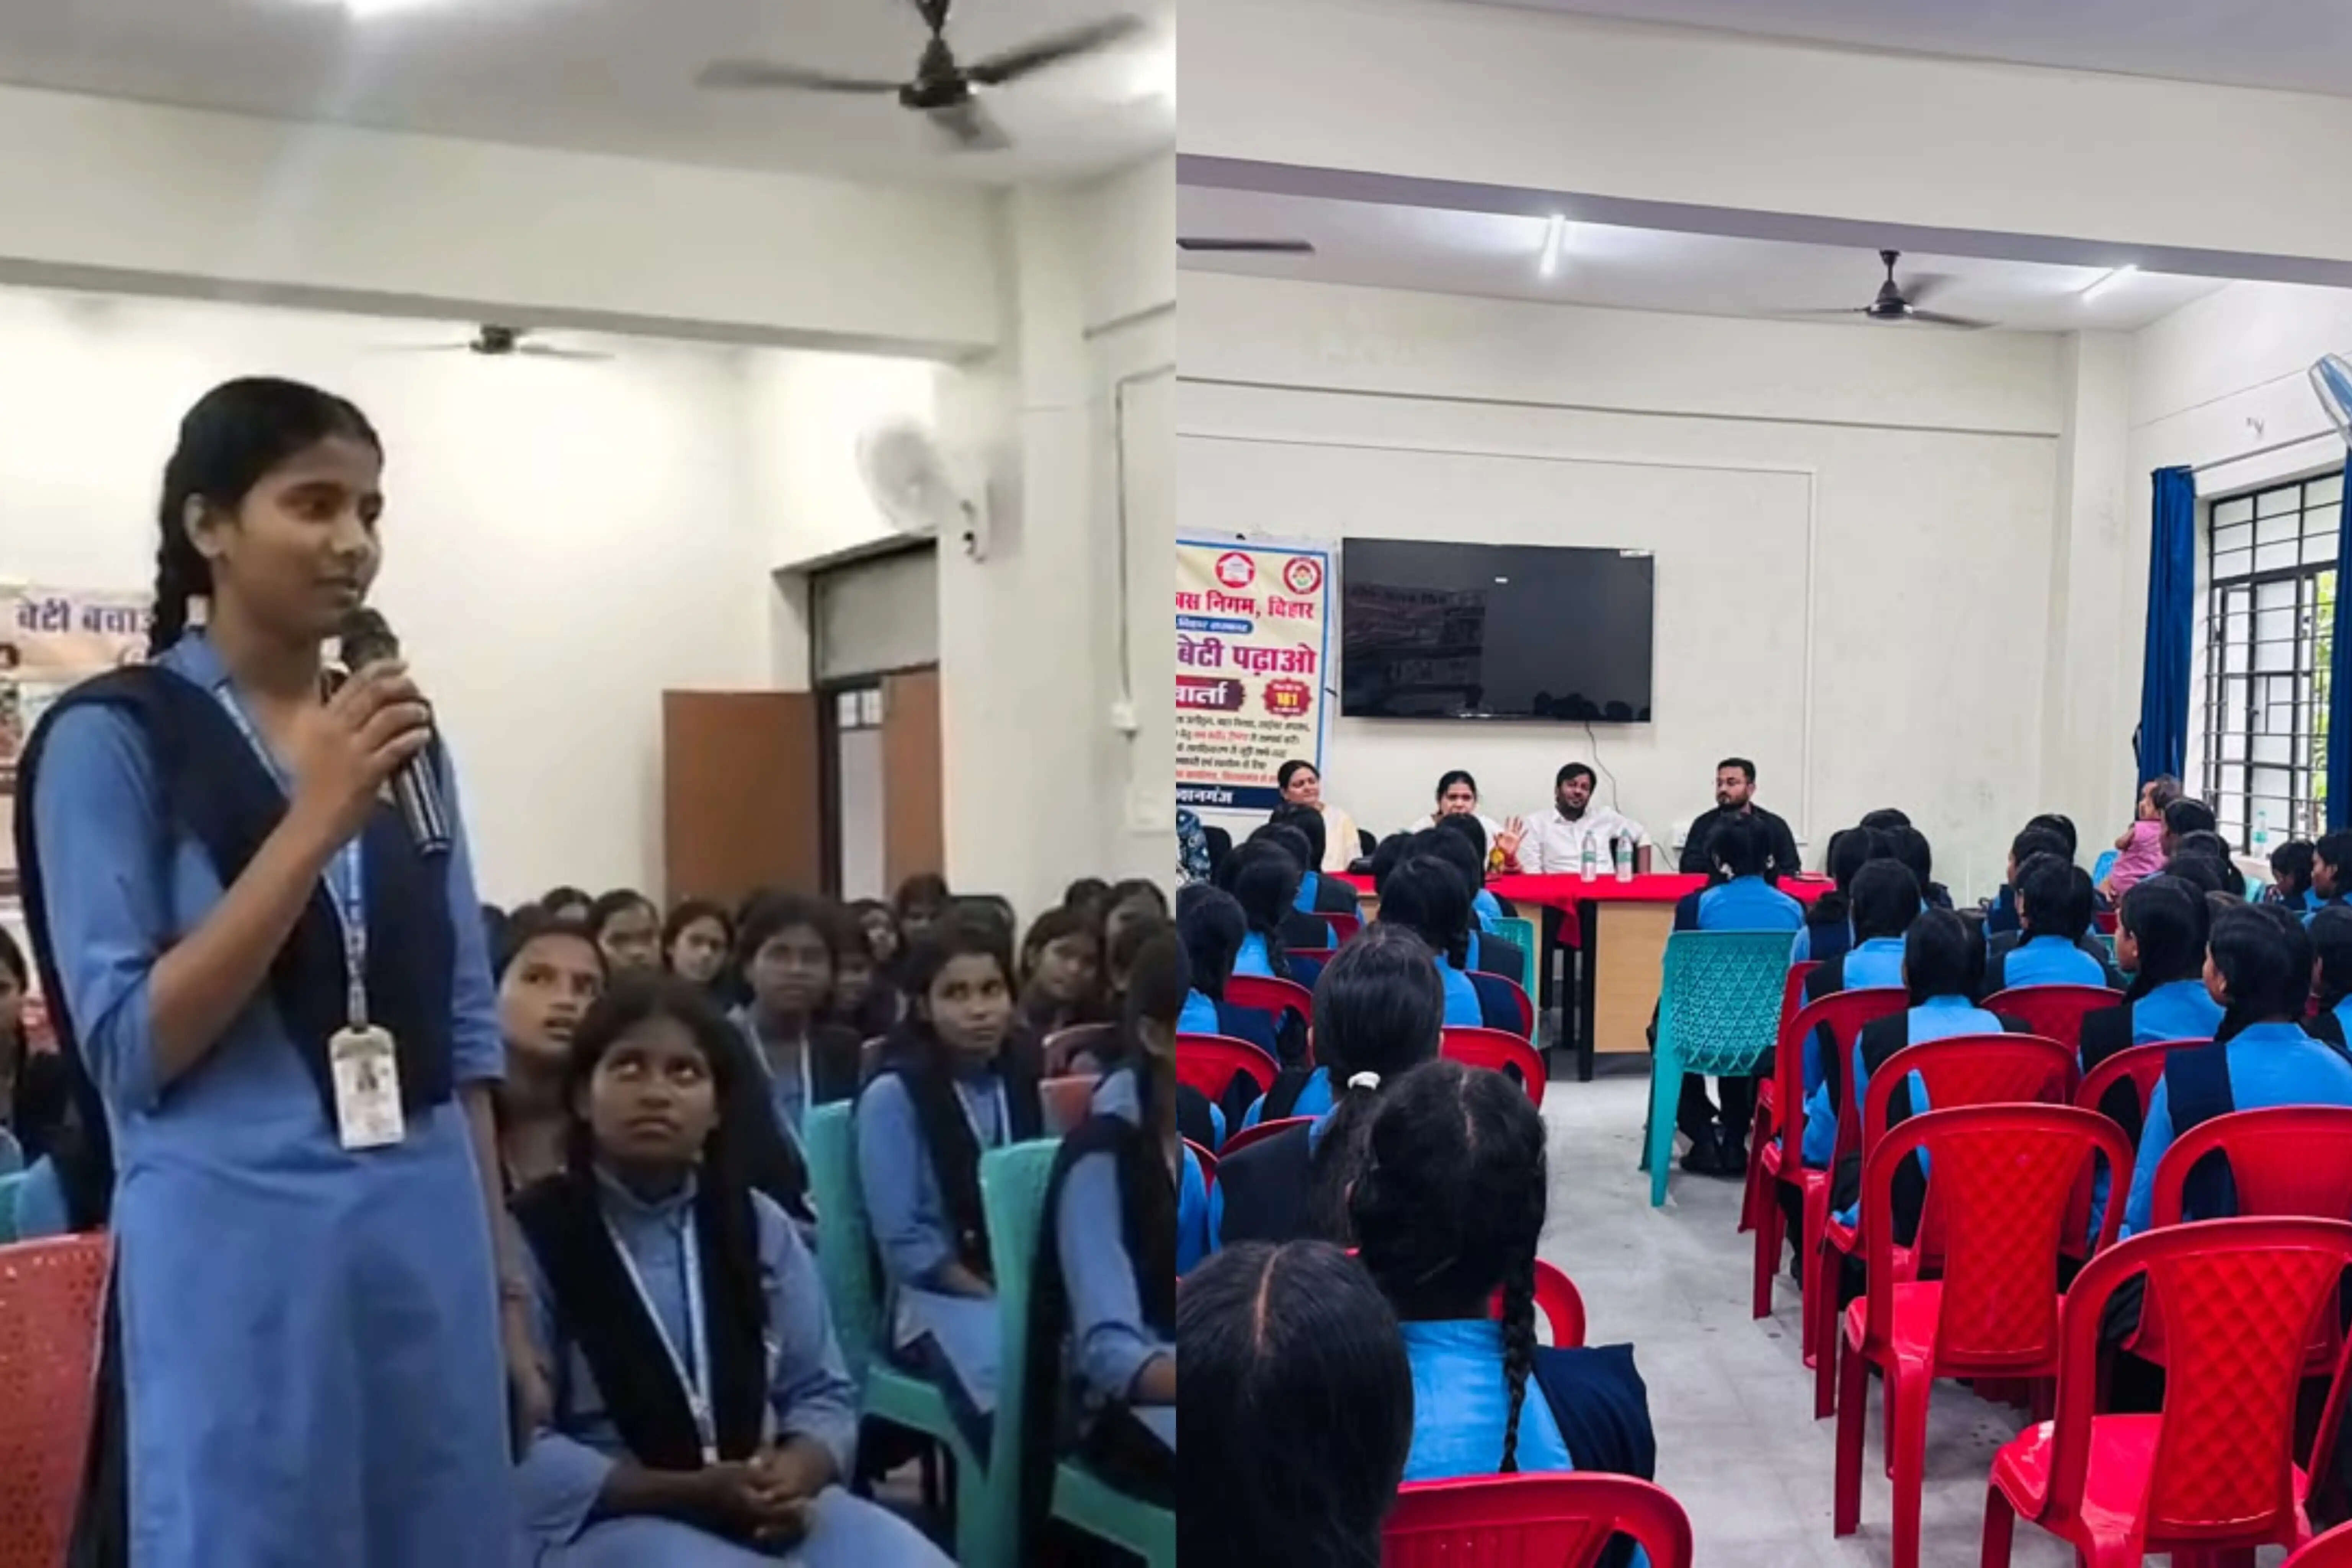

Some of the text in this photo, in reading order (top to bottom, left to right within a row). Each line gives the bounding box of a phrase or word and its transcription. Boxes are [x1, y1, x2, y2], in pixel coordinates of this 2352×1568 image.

[1176, 590, 1314, 618] ास निगम, बिहार
[1177, 634, 1317, 676] बेटी पढ़ाओ
